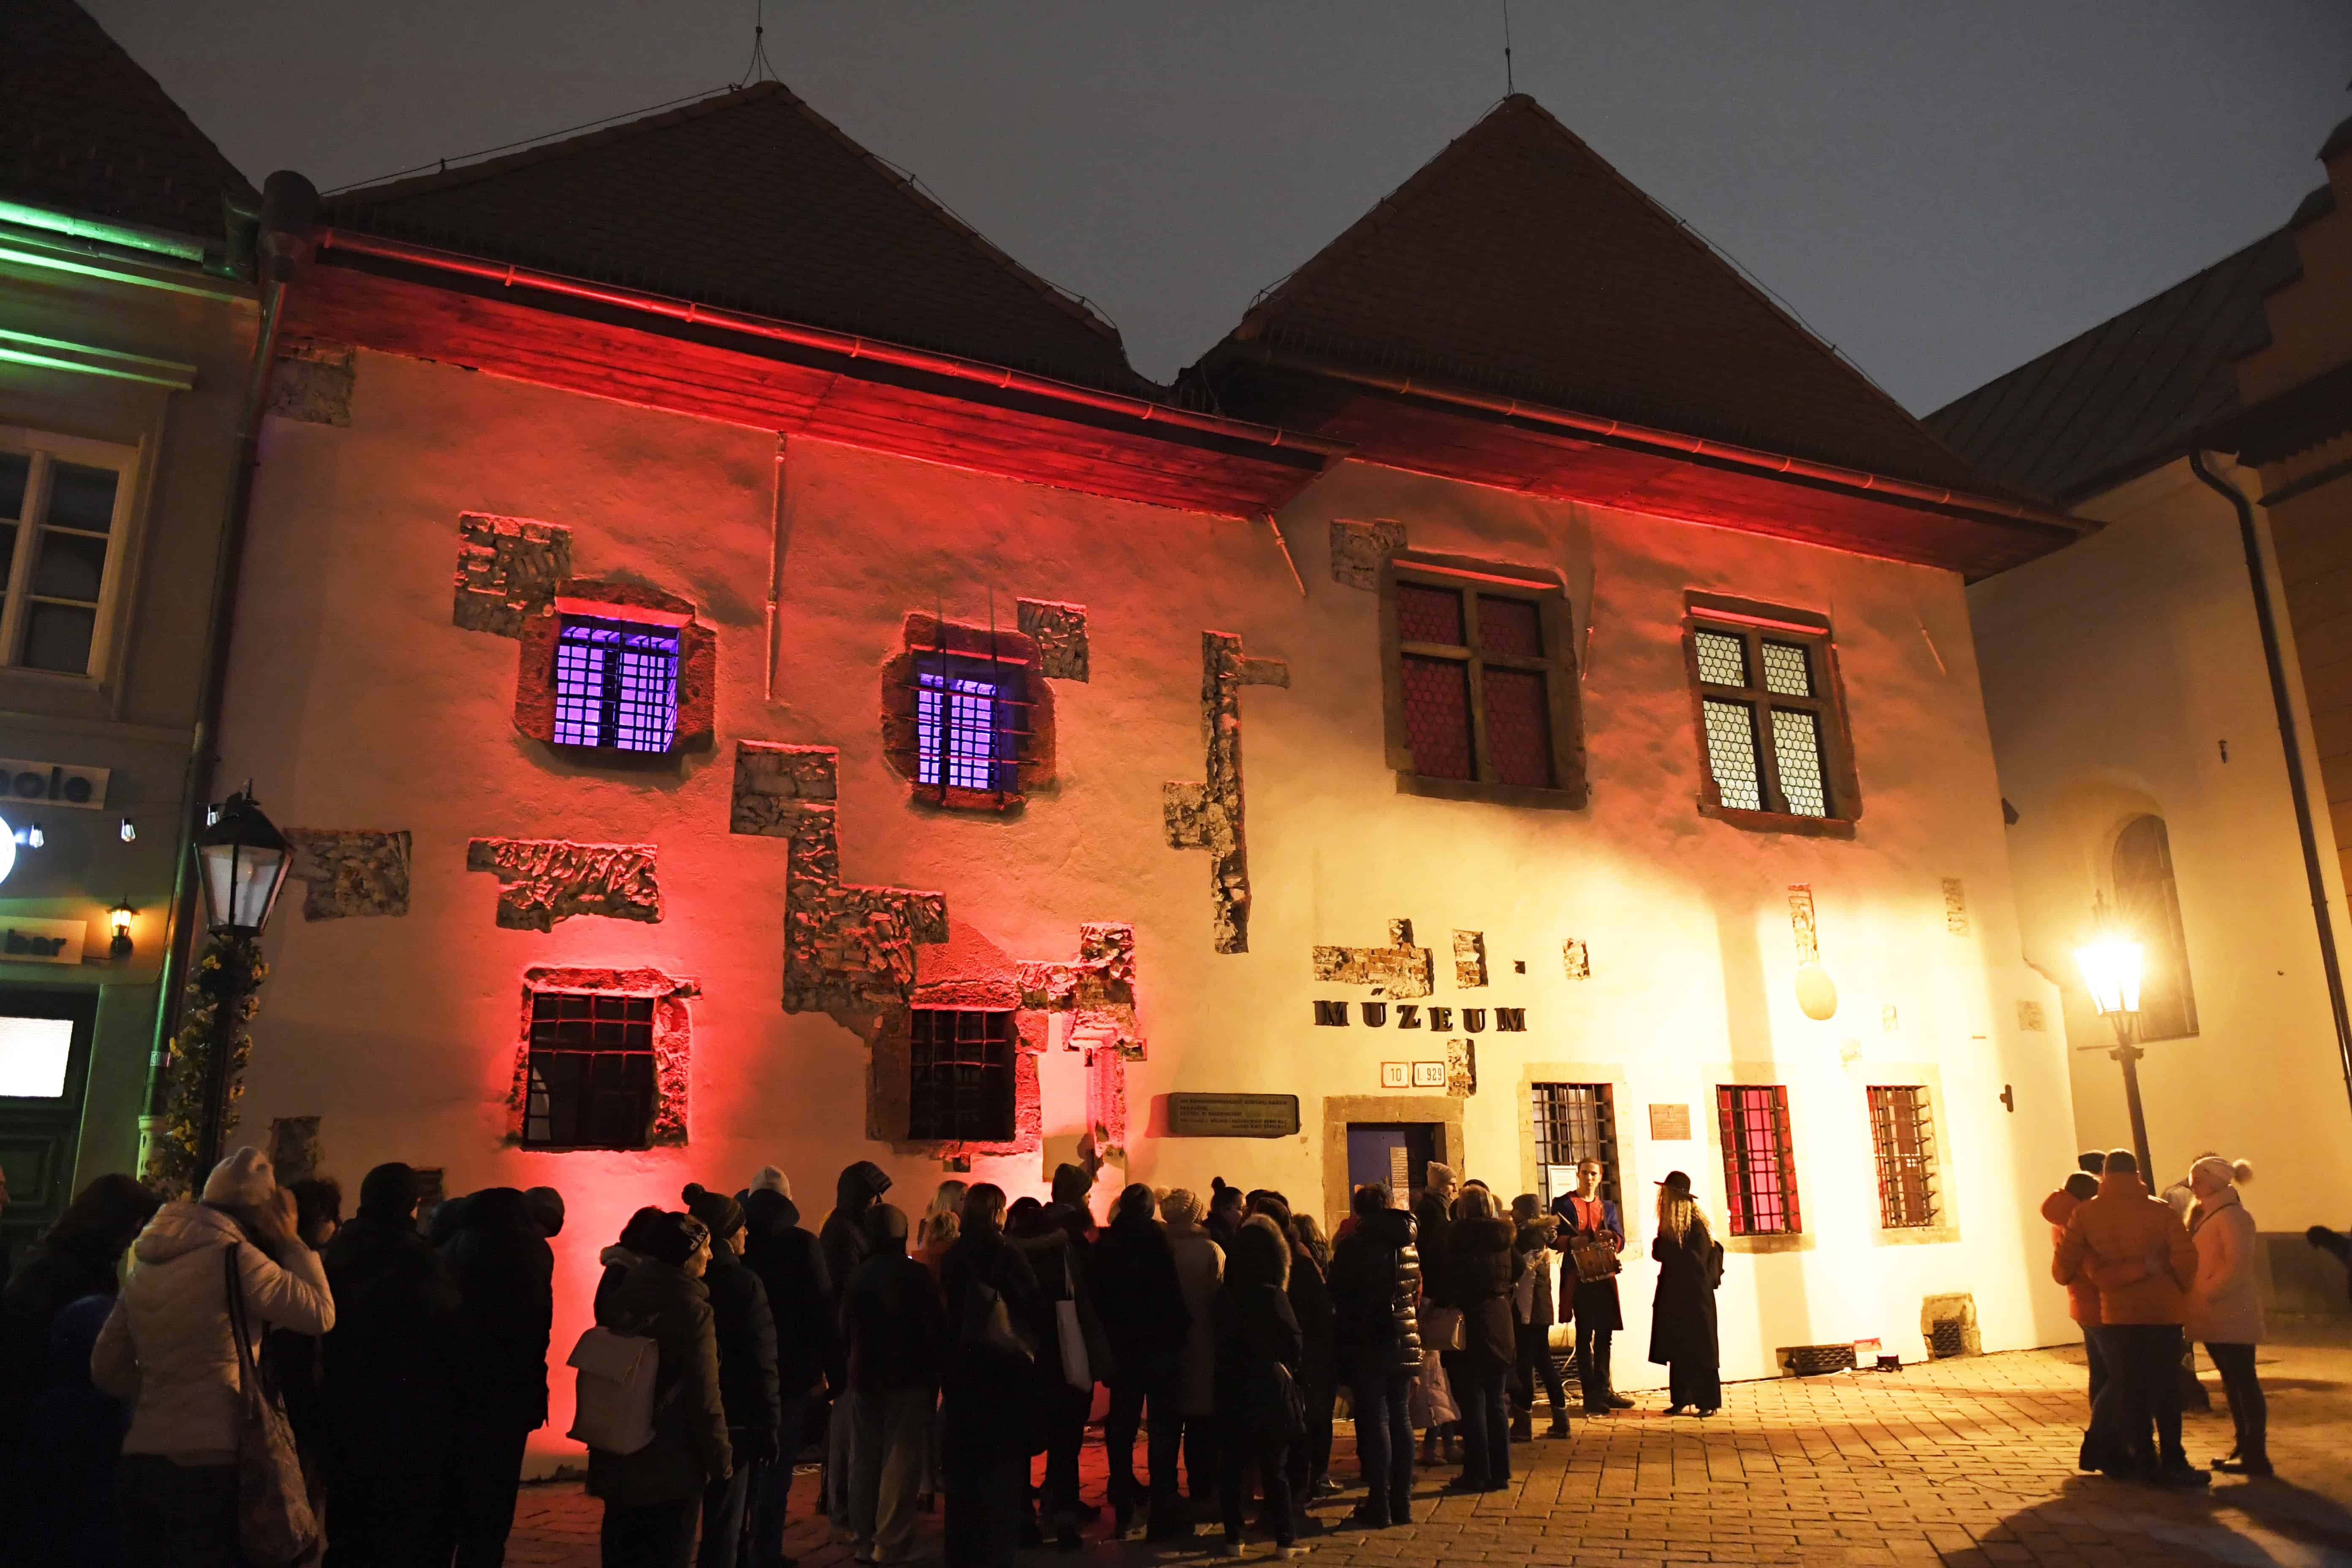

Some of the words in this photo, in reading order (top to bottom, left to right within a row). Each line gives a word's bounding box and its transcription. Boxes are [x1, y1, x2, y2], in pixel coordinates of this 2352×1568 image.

[5, 929, 67, 956] bar
[1312, 988, 1527, 1033] MÚZEUM
[1391, 1068, 1401, 1082] 10
[1427, 1068, 1442, 1081] 929
